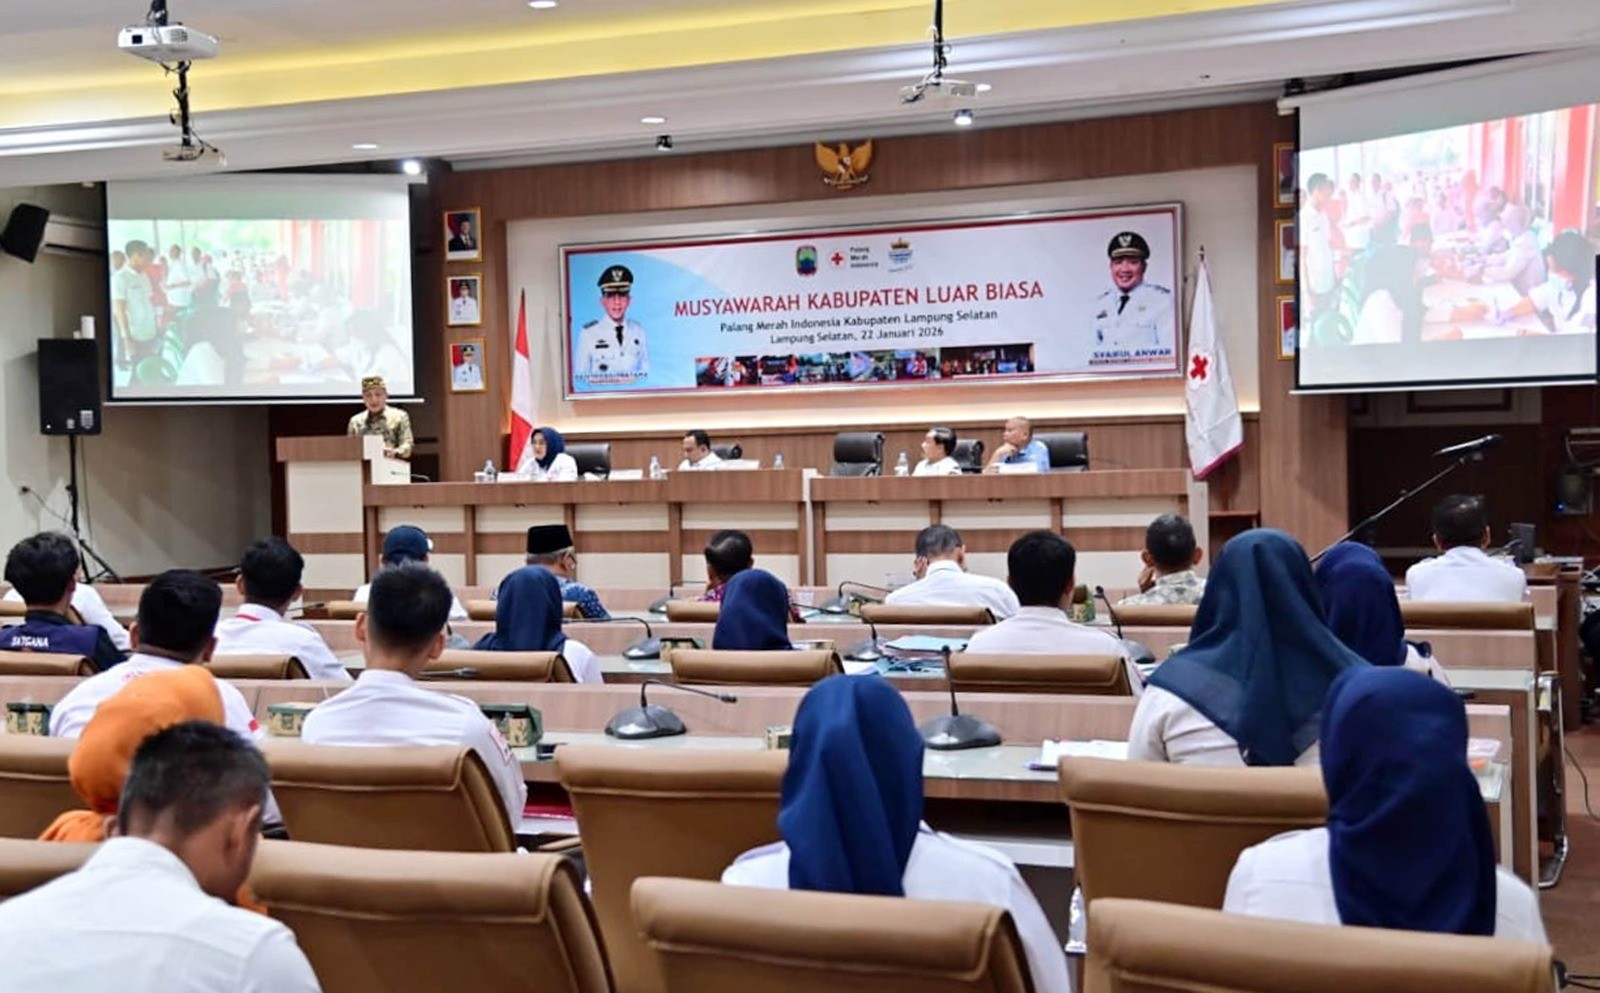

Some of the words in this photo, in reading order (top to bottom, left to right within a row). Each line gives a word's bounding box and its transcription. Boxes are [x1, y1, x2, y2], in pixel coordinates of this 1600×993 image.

[674, 295, 801, 317] MUSYAWARAH
[807, 288, 919, 310] KABUPATEN
[926, 284, 979, 304] LUAR
[985, 280, 1044, 300] BIASA
[720, 320, 753, 334] Palang
[756, 318, 789, 331] Merah
[791, 316, 841, 329] Indonesia
[843, 314, 900, 329] Kabupaten
[904, 310, 953, 326] Lampung
[956, 308, 998, 321] Selatan
[770, 332, 815, 346] Lampung
[817, 329, 858, 343] Selatan,
[861, 328, 875, 340] 22
[877, 326, 915, 339] Januari
[918, 325, 944, 337] 2026
[1134, 348, 1172, 357] ANWAR
